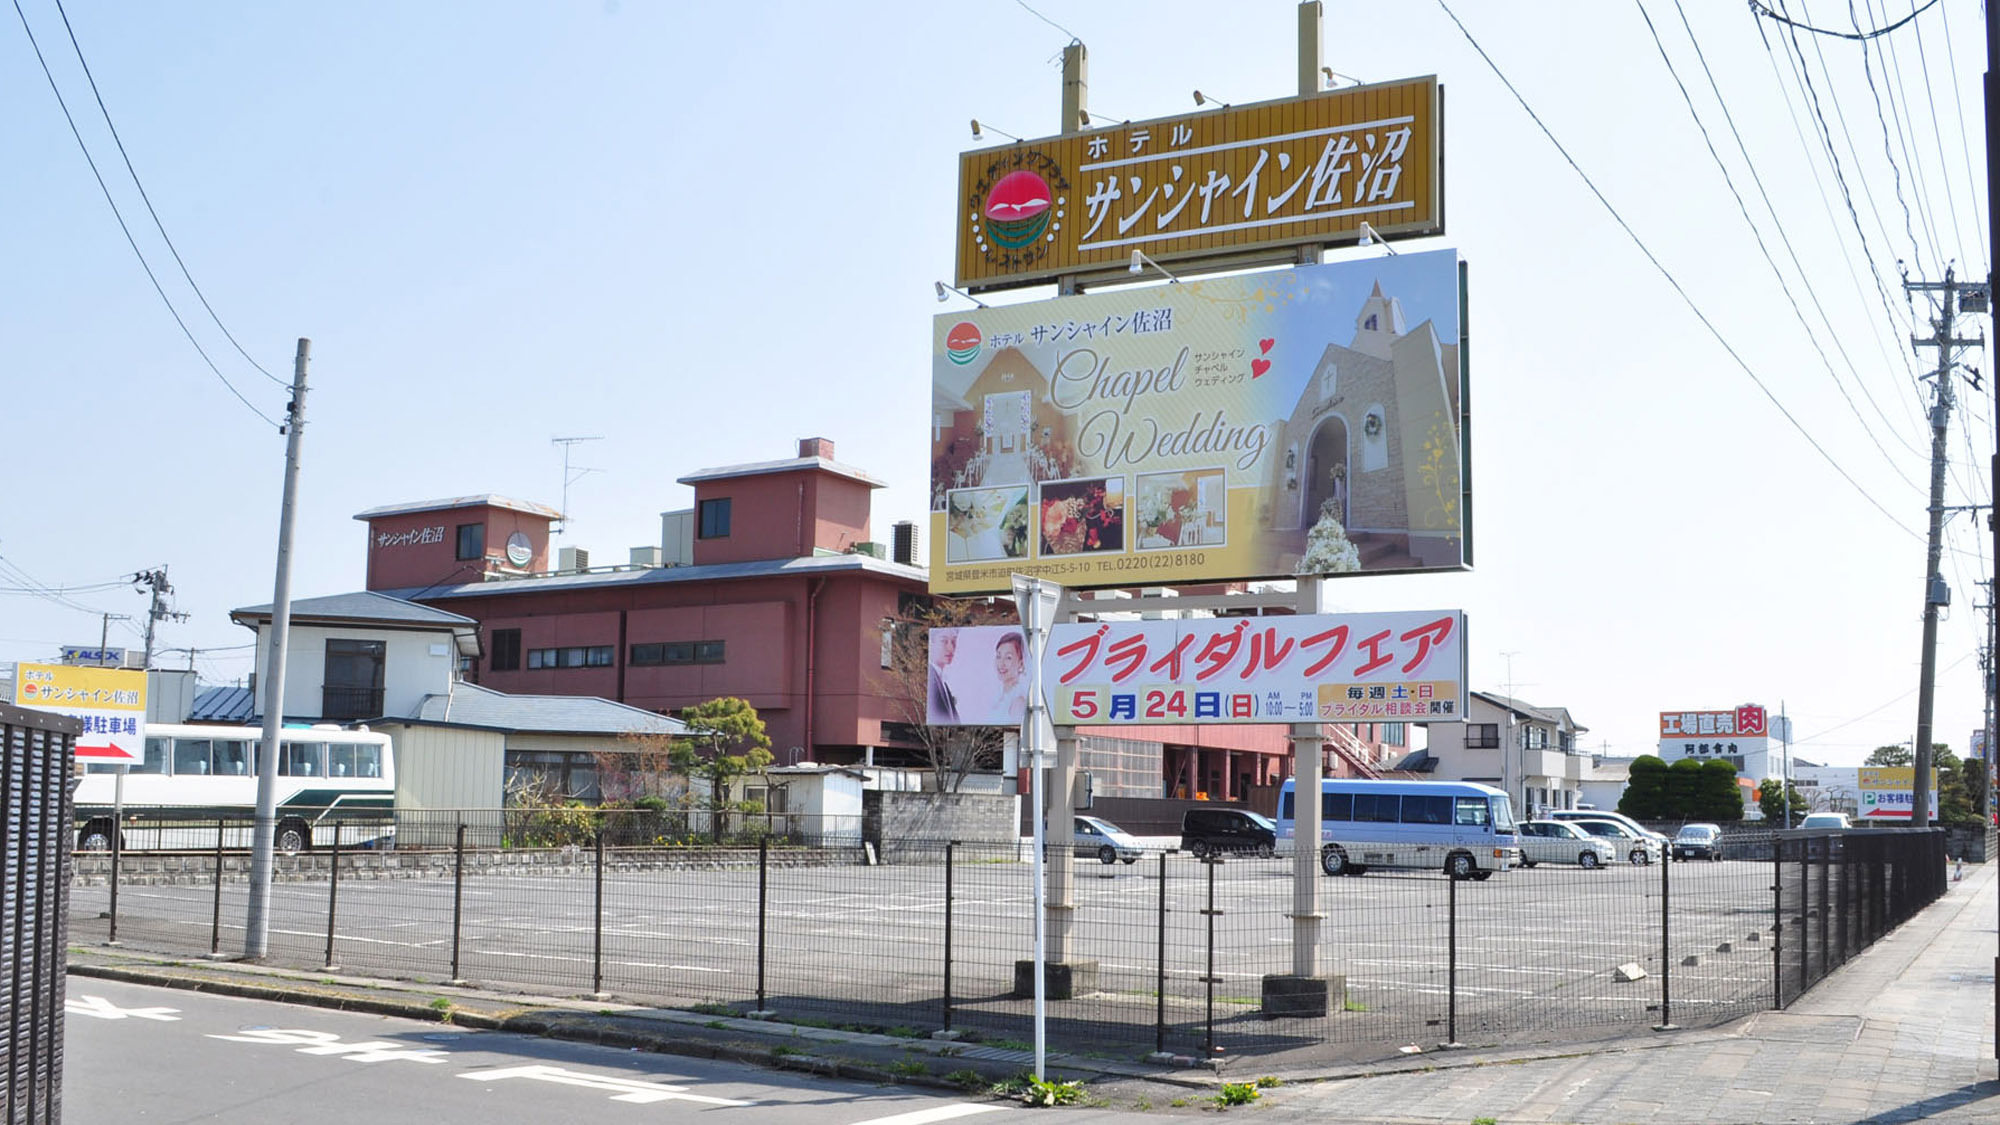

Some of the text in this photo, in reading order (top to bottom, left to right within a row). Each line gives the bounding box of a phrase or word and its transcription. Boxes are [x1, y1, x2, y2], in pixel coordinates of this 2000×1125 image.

[1088, 125, 1192, 159] ホテル
[1083, 126, 1412, 240] サンシャイン佐沼
[990, 308, 1172, 348] ホテル サンシャイン佐沼
[1194, 349, 1245, 362] サンシャイン
[1050, 346, 1189, 414] Chapel
[1194, 364, 1228, 374] チャペル
[1194, 373, 1245, 387] ウェディング
[1078, 409, 1271, 471] Wedding
[377, 526, 445, 548] サンシャイン佐沼
[1056, 616, 1454, 684] ブライダルフェア
[25, 670, 53, 681] ホテル
[41, 686, 139, 704] サンシャイン佐沼
[1267, 691, 1313, 700] AM PM
